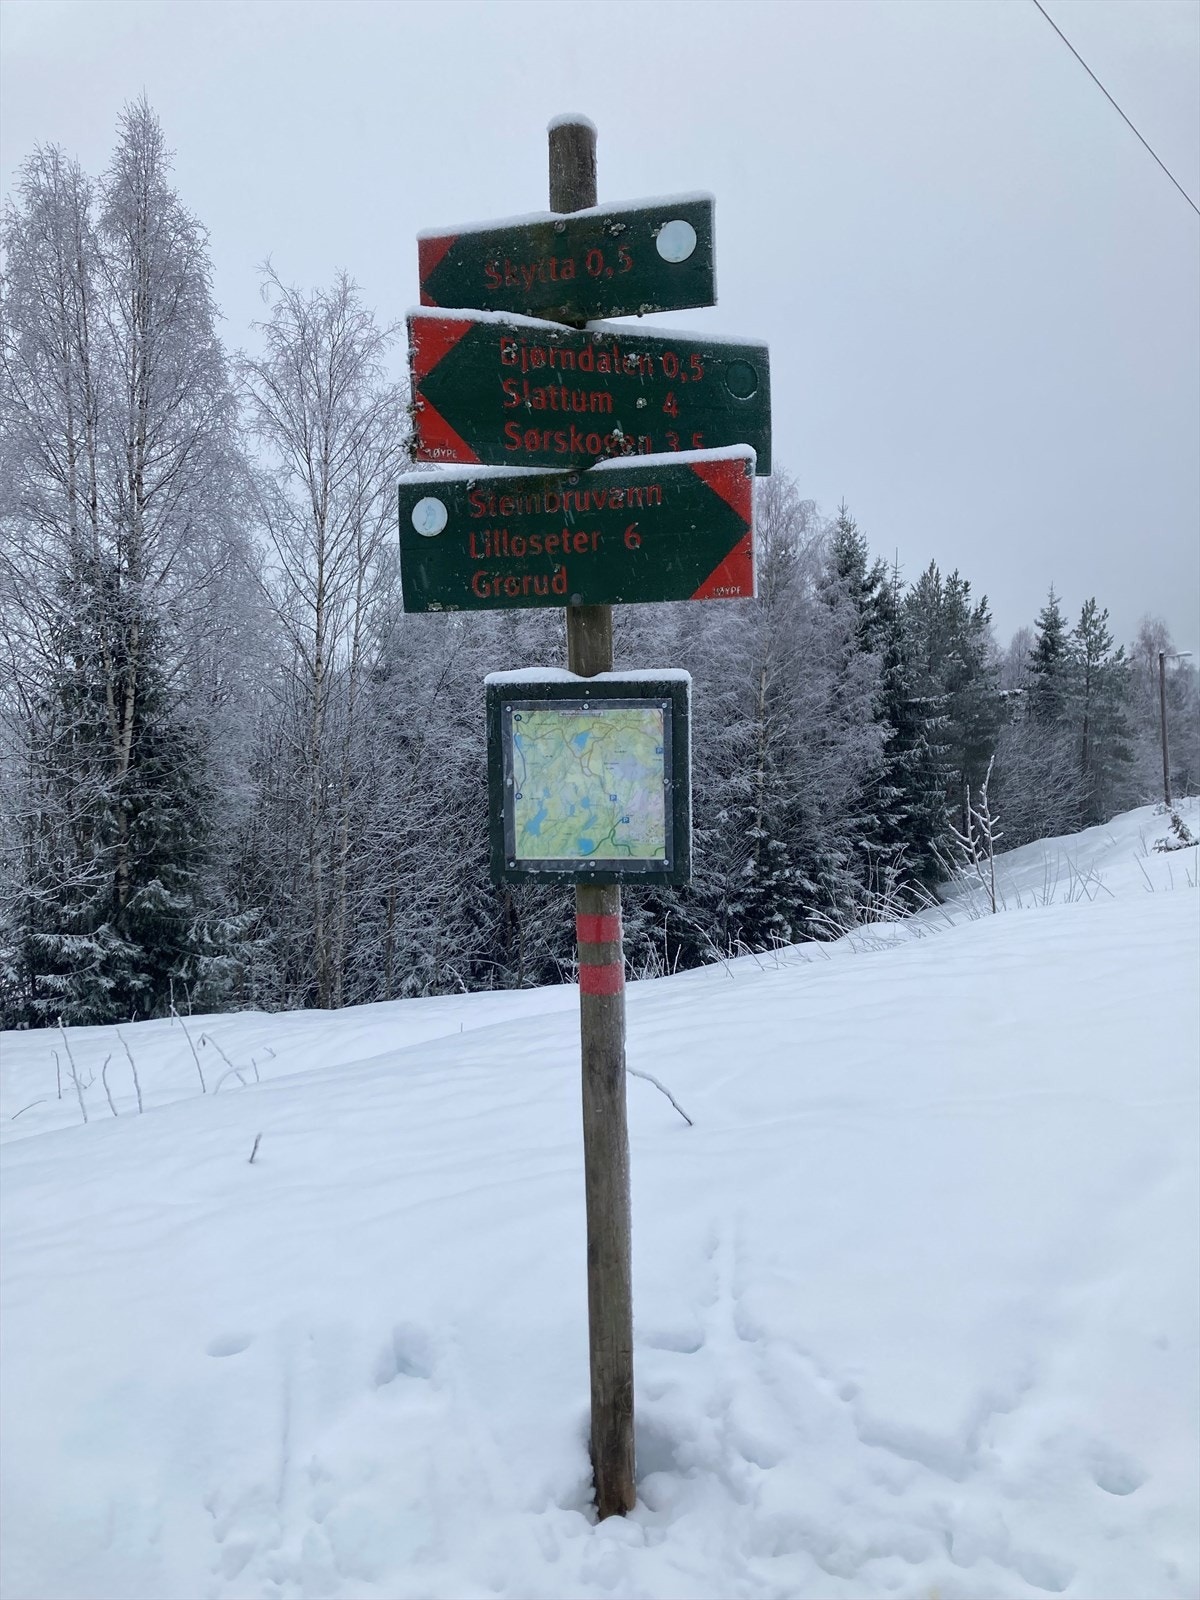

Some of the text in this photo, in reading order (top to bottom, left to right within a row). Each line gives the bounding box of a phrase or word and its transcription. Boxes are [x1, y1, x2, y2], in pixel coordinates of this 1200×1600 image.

[484, 243, 634, 292] Skytta 0,5
[500, 336, 704, 383] Bjørndalen 0,5
[502, 378, 679, 418] Slattum 4
[665, 431, 704, 453] 35
[468, 484, 663, 519] Steinbruvann
[468, 522, 642, 559] Lilloseter 6
[471, 565, 569, 598] Grorud
